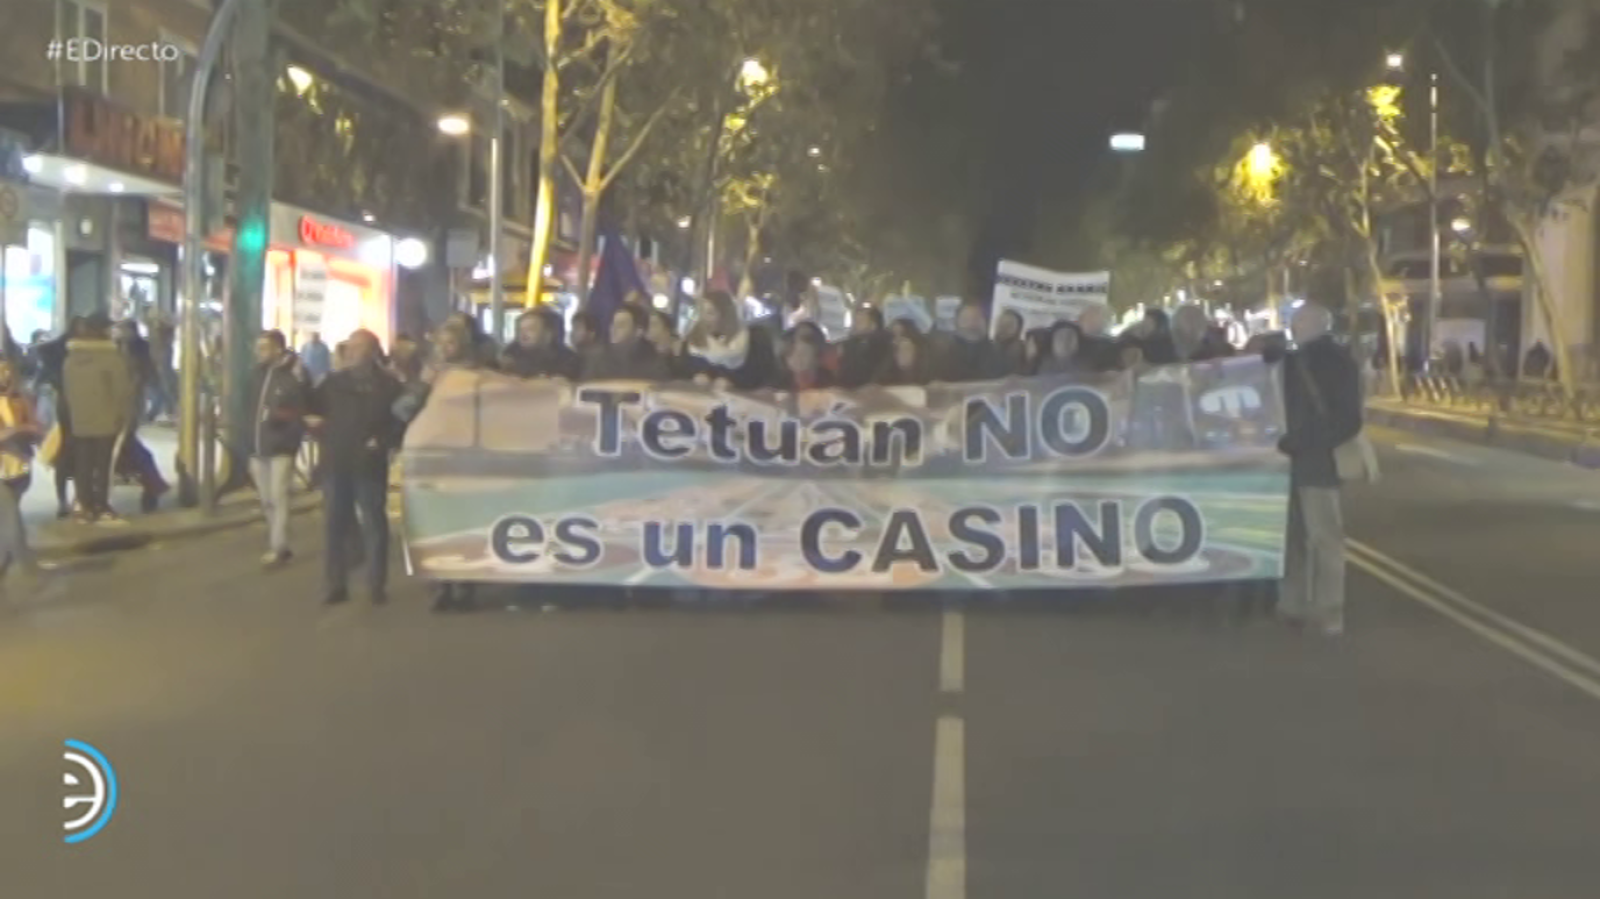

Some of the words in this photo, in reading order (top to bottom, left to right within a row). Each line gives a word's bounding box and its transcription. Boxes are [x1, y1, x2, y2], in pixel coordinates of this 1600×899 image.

[578, 386, 924, 467] Tetuán
[963, 385, 1110, 463] NO
[490, 513, 604, 566] es
[642, 519, 759, 571] un
[799, 494, 1206, 574] CASINO
